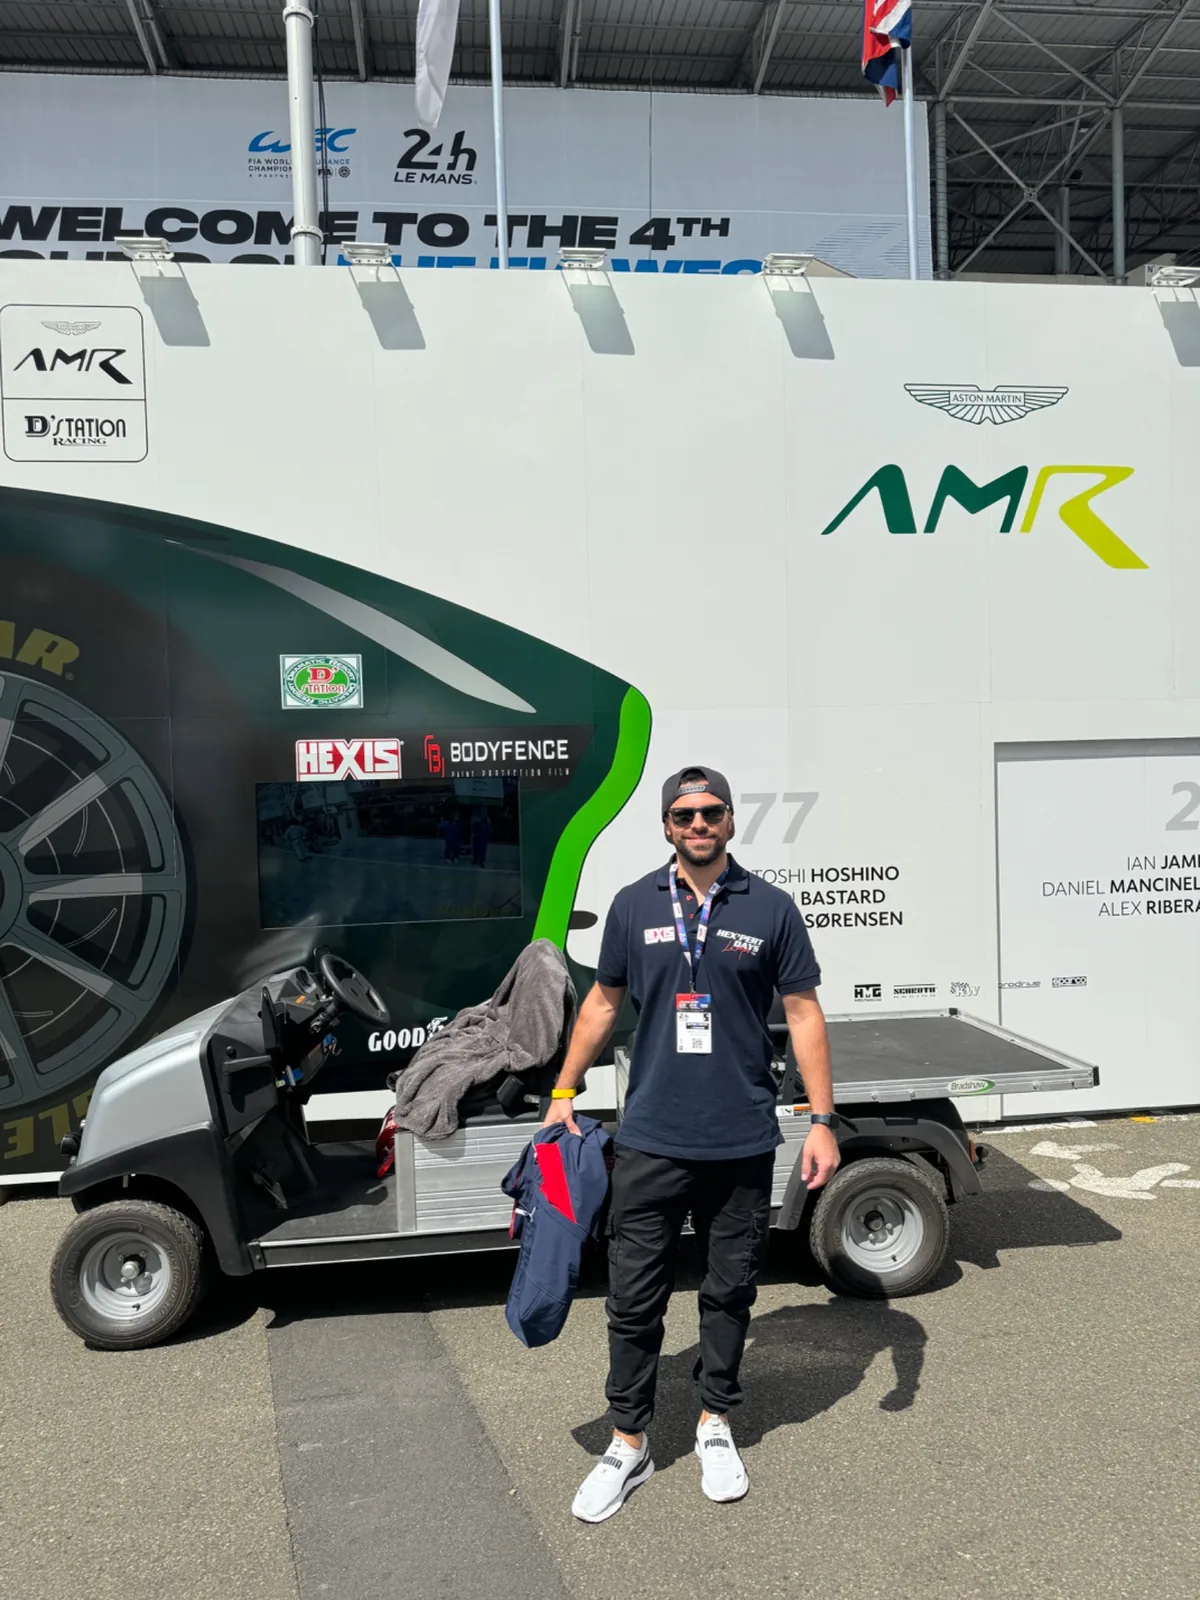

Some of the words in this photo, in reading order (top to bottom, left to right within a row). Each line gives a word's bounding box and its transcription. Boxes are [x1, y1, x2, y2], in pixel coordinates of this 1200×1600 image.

[396, 128, 477, 171] 24h
[394, 171, 416, 183] LE
[420, 173, 473, 185] MANS
[0, 205, 359, 246] WELCOME
[372, 211, 470, 248] TO
[484, 213, 619, 250] THE
[629, 217, 731, 251] 4TH
[13, 348, 133, 385] AMR
[953, 393, 984, 403] ASTON
[986, 394, 1022, 404] MARTIN
[52, 437, 107, 446] RACING
[820, 463, 1150, 570] AMR
[450, 739, 569, 762] BODYFENCE
[296, 739, 401, 781] HEXIS
[739, 791, 820, 845] 77
[1127, 856, 1156, 871] IAN
[1161, 854, 1200, 870] JAM
[752, 868, 806, 884] TOSHI
[811, 866, 900, 883] HOSHINO
[1042, 880, 1105, 897] DANIEL
[801, 889, 886, 906] BASTARD
[1098, 901, 1142, 917] ALEX
[804, 911, 903, 929] SØRENSEN
[950, 1081, 987, 1091] Bradshaw
[704, 1437, 730, 1450] PUMA
